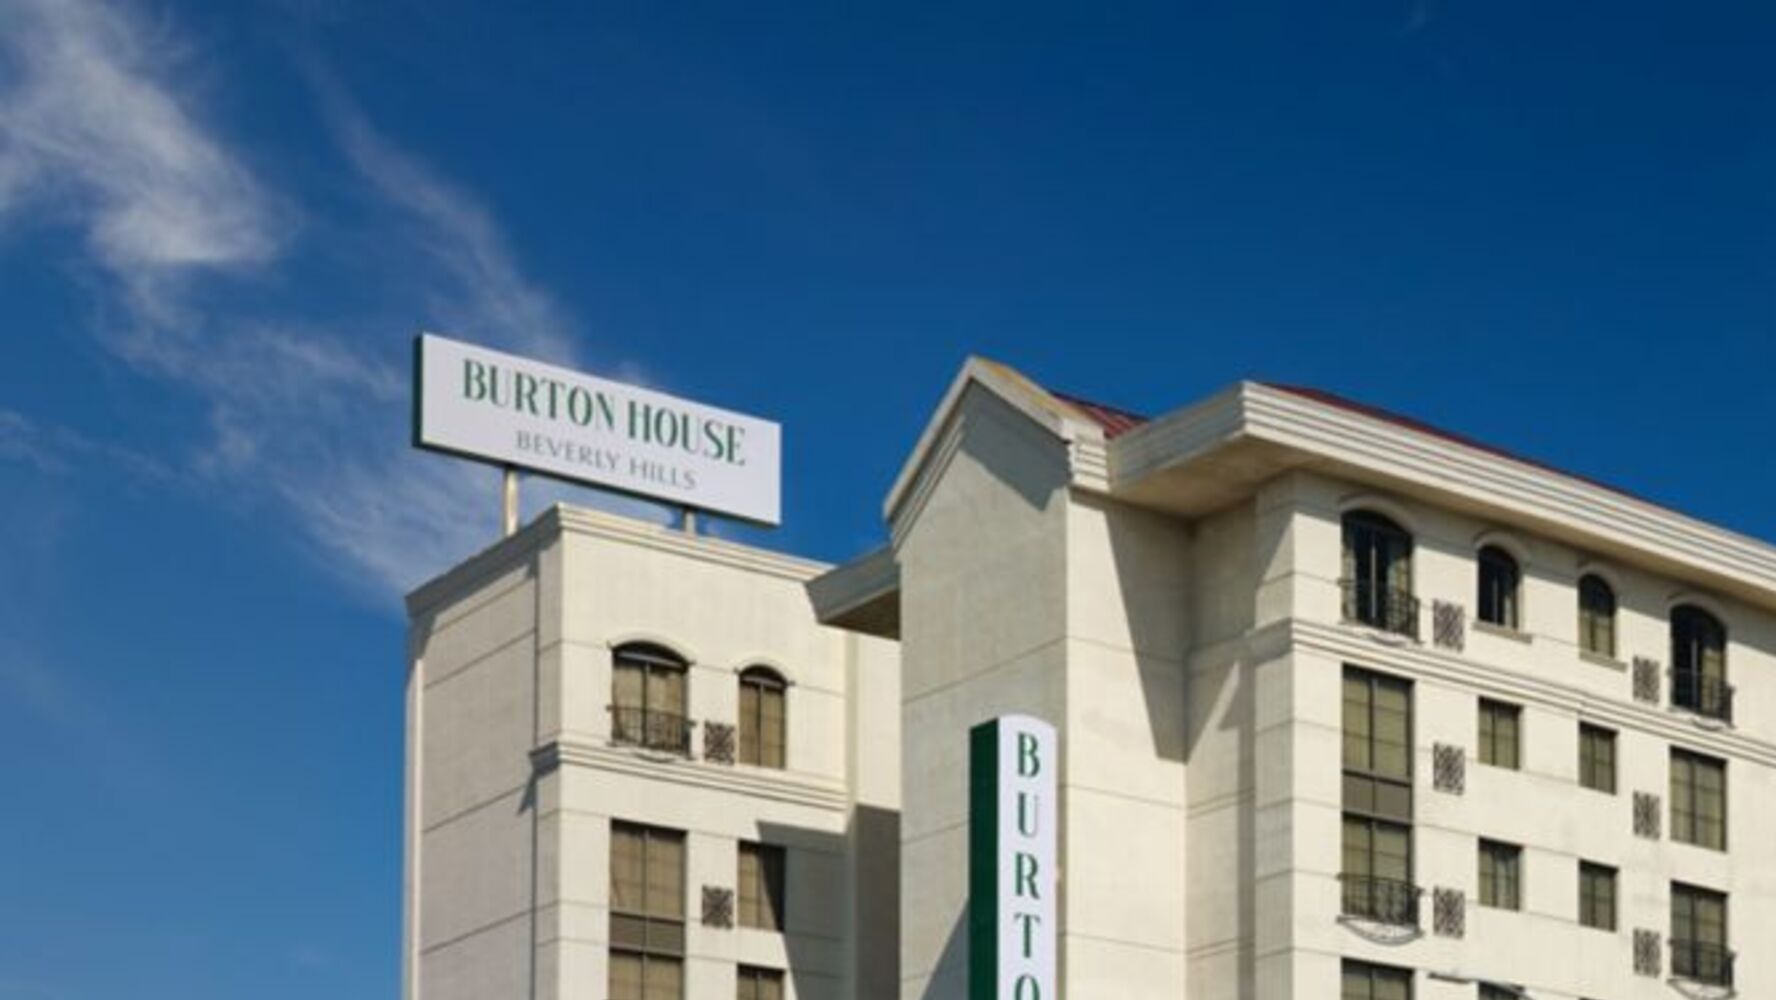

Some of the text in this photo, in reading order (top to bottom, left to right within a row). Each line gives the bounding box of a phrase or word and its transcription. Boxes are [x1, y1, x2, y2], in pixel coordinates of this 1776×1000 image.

[463, 358, 746, 466] BURTON HOUSE
[516, 430, 696, 490] BEVERLY HILLS
